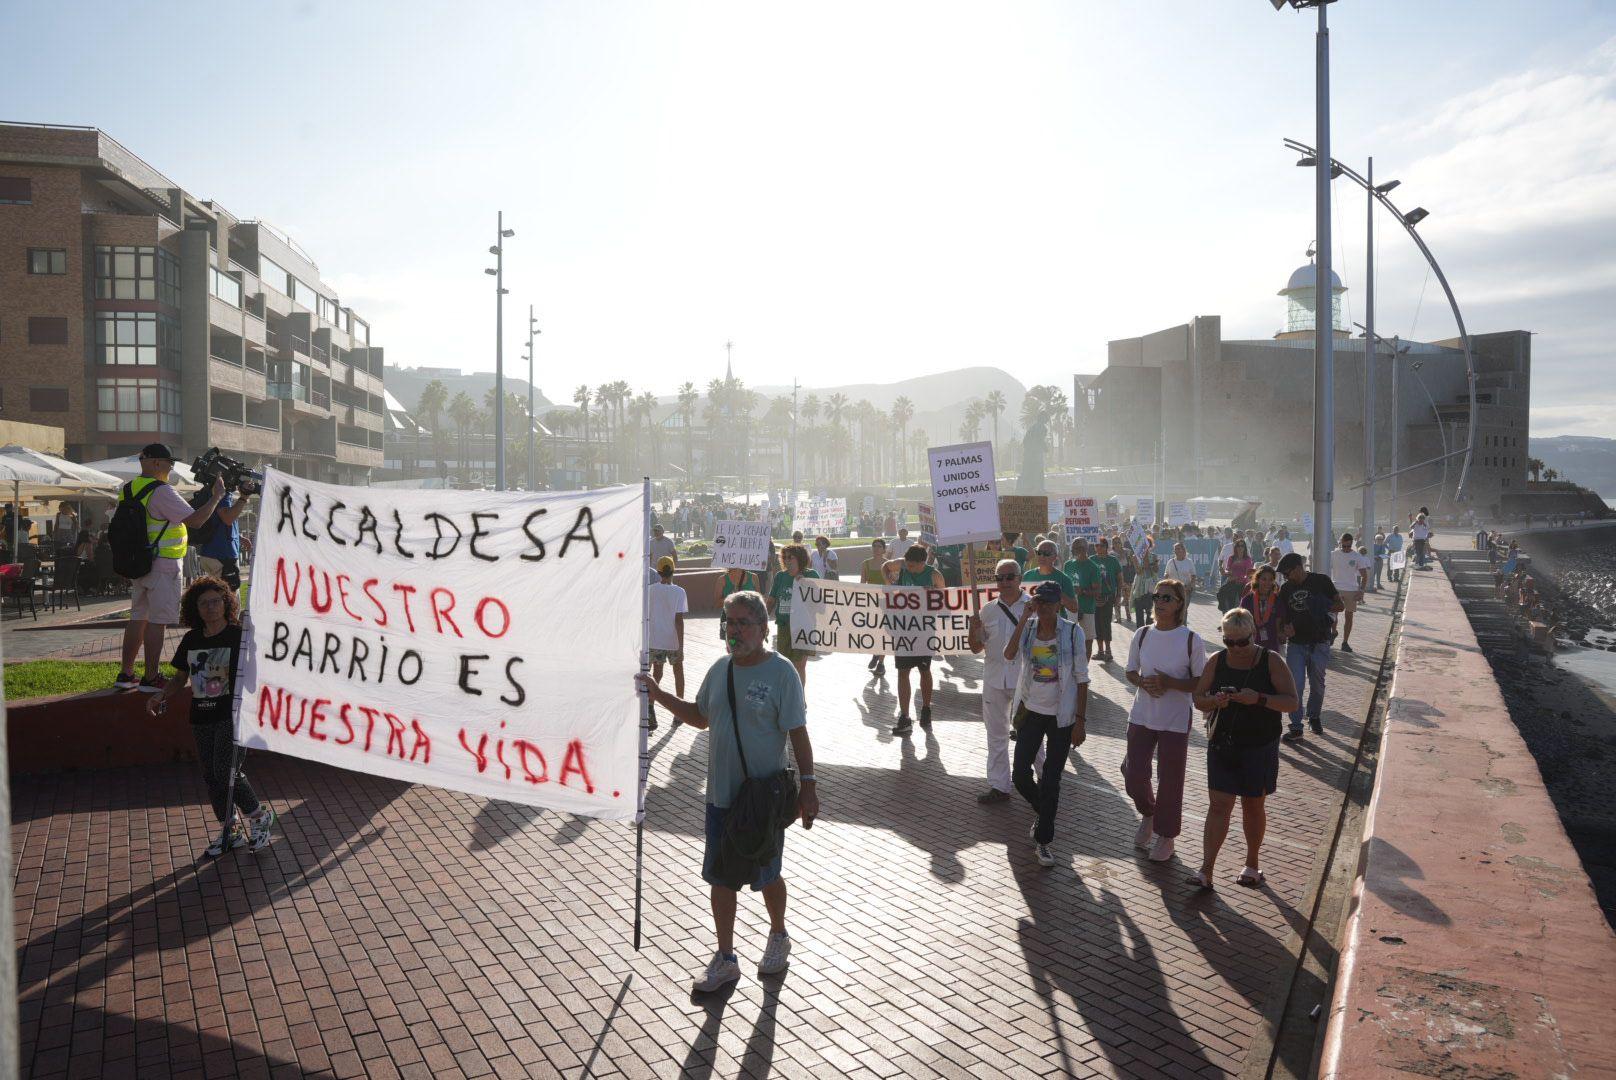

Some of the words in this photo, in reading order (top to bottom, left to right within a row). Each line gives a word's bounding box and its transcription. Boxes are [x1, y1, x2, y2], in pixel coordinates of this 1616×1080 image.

[945, 455, 983, 467] PALMAS
[943, 471, 980, 482] UNIDOS
[937, 487, 969, 498] SOMOS
[970, 484, 990, 494] MÁS
[949, 501, 976, 512] LPGC
[274, 557, 511, 638] NUESTRO
[799, 586, 879, 608] VUELVEN
[885, 593, 920, 610] LOS
[828, 610, 841, 627] A
[795, 626, 837, 648] AQUÍ
[848, 633, 875, 649] NO
[882, 636, 918, 651] HAY
[459, 655, 525, 706] ES
[258, 685, 431, 763] NUESTRA
